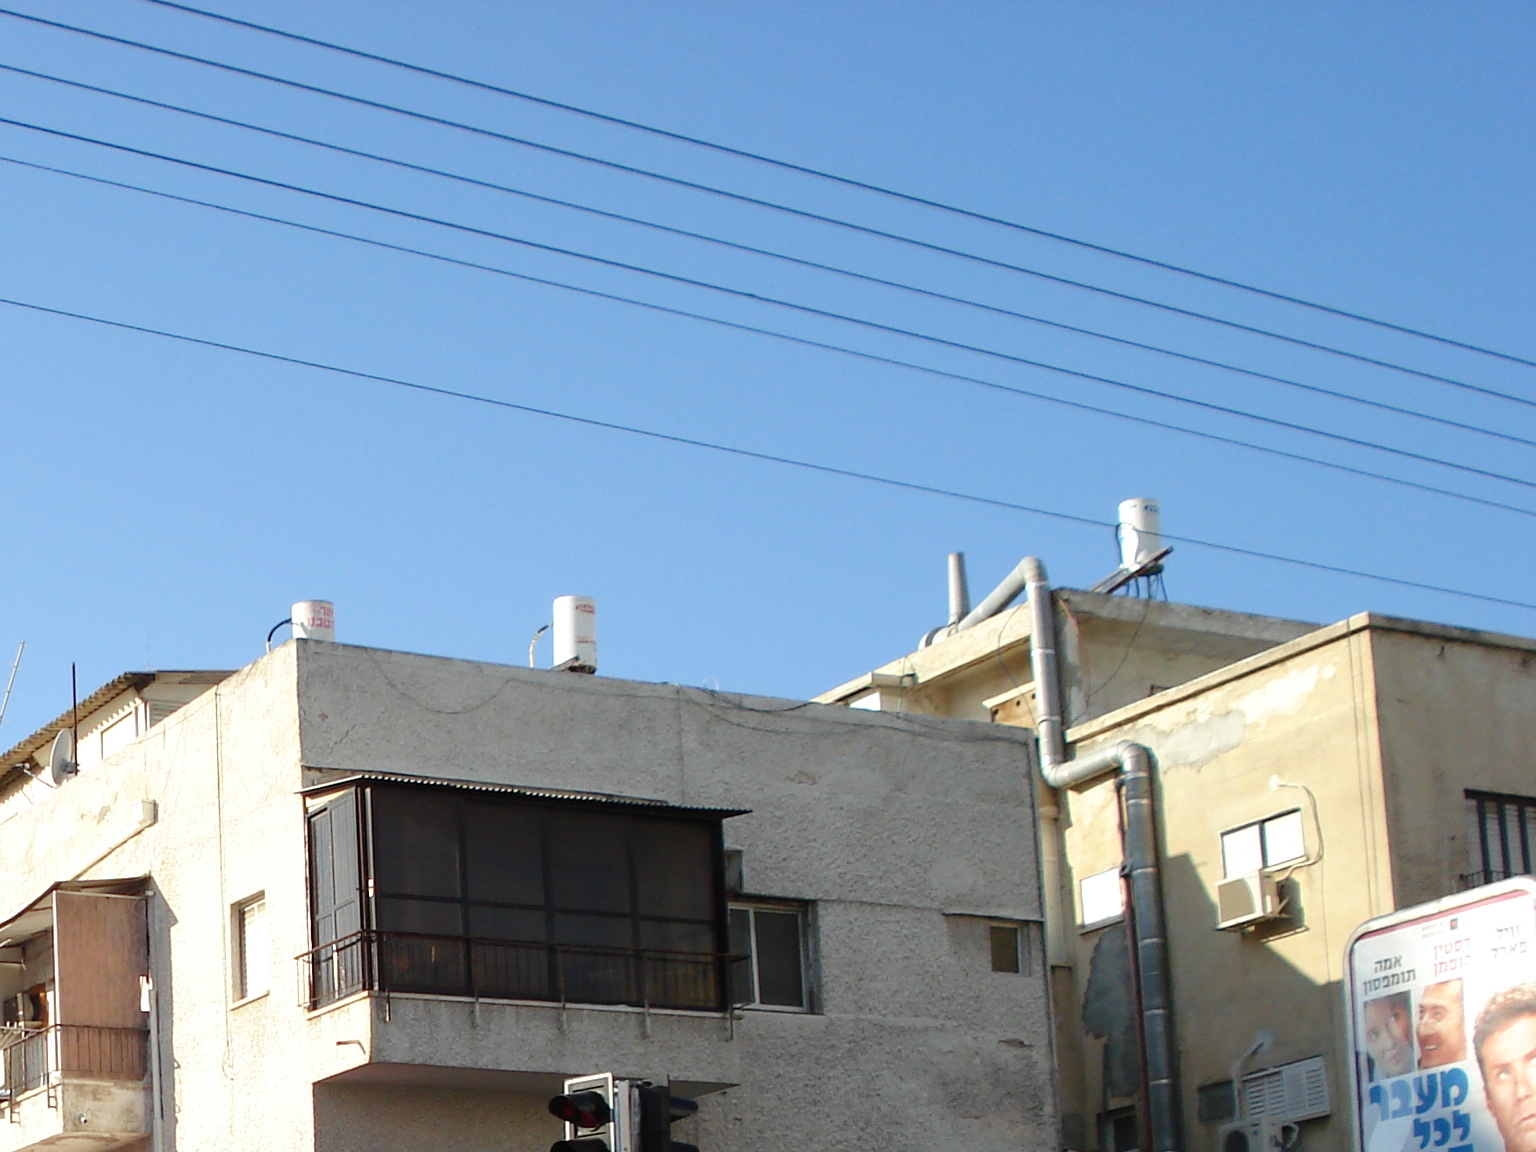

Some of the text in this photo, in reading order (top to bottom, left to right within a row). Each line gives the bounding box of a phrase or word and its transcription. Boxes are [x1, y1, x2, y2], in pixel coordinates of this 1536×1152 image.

[1433, 938, 1470, 960] דסטין
[1374, 955, 1402, 974] אמה
[1433, 955, 1472, 977] הופמן
[1363, 968, 1416, 996] תומפסון
[1368, 1067, 1470, 1122] מעבר
[1413, 1109, 1471, 1150] לכל
